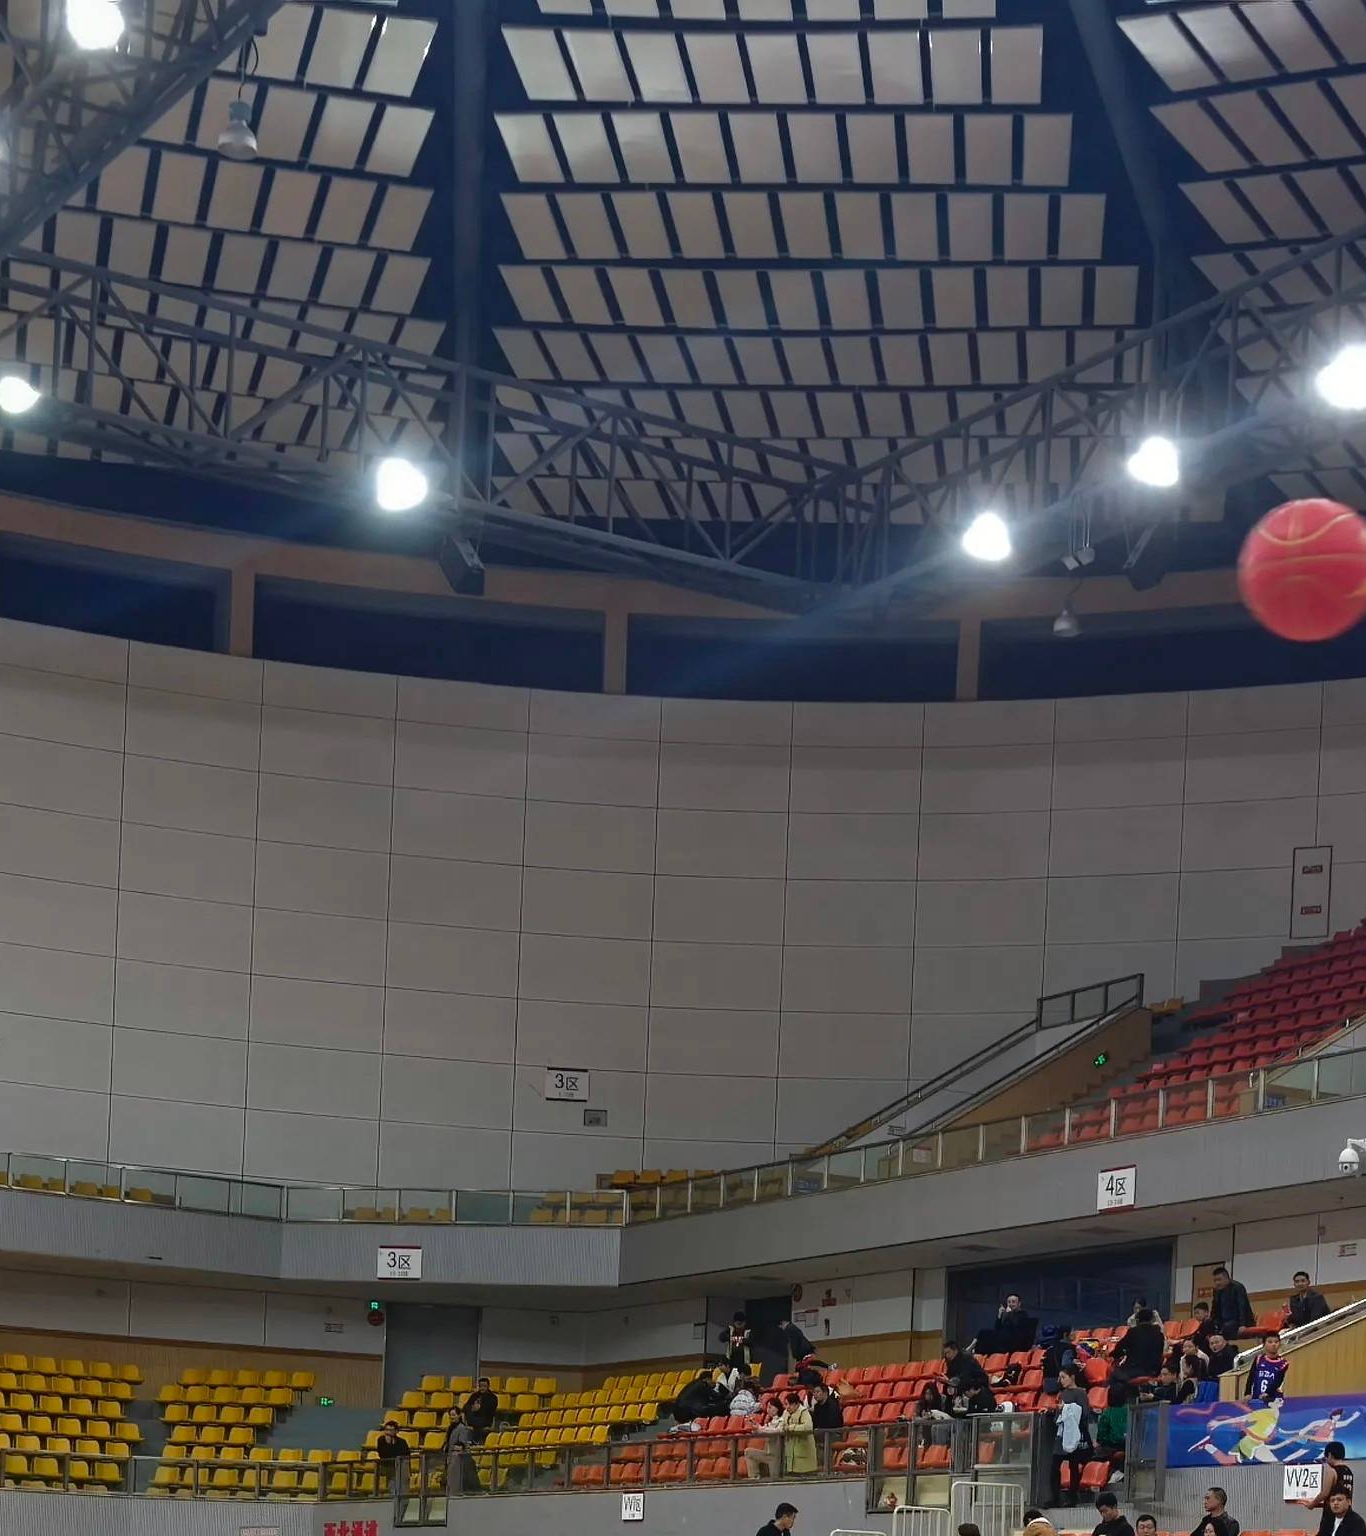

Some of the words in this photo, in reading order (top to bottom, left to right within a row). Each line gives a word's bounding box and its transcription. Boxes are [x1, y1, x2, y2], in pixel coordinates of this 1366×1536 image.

[554, 1072, 580, 1091] 3区
[1105, 1174, 1127, 1196] 4区
[386, 1251, 412, 1270] 3区
